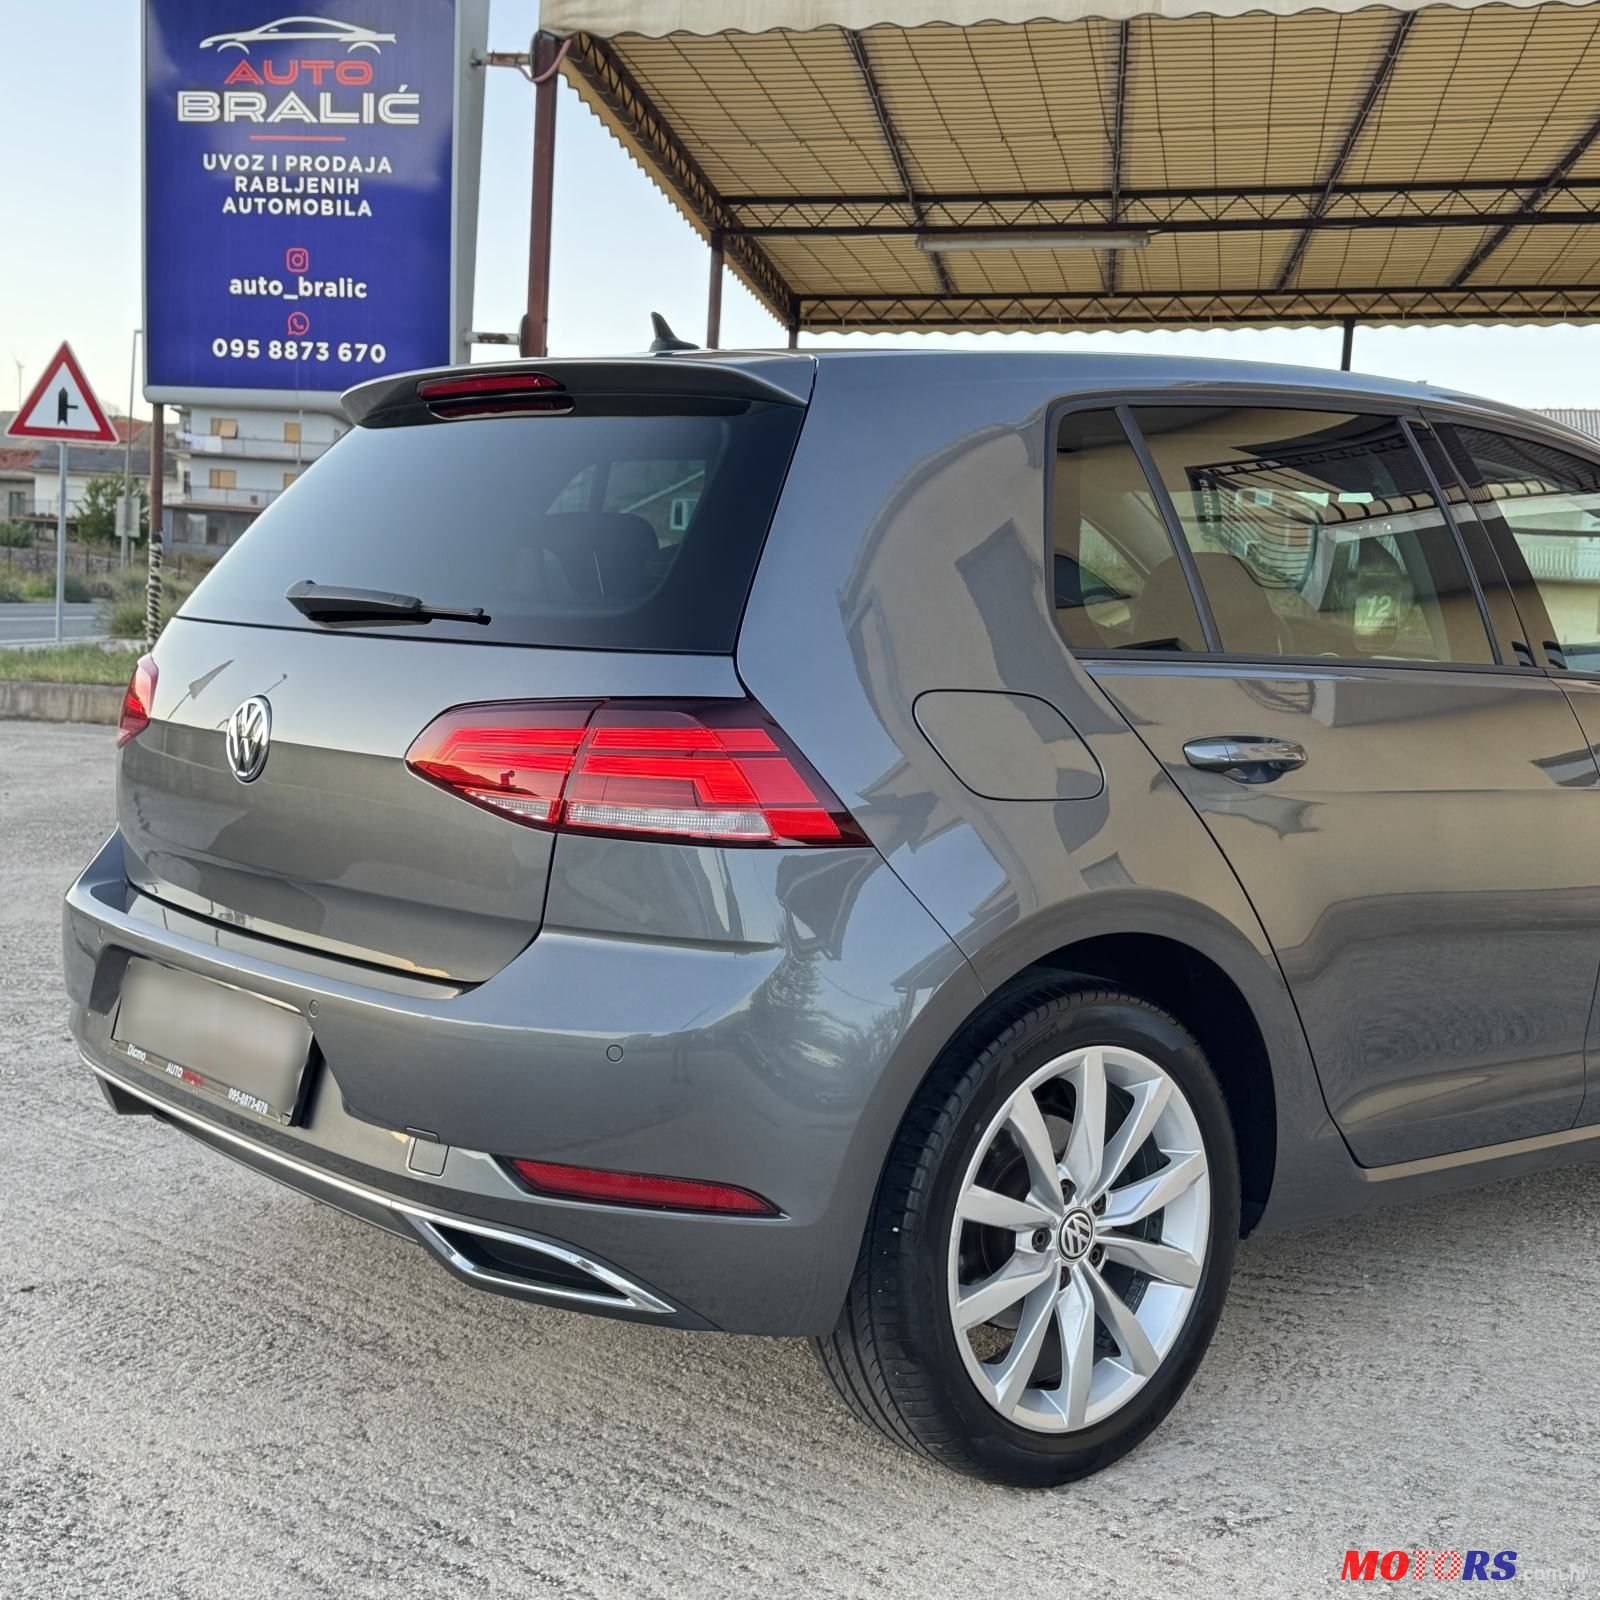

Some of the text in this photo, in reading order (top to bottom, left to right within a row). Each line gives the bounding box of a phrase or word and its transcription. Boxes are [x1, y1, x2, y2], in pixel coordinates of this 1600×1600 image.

[224, 59, 373, 85] AUTO
[177, 84, 420, 125] BRALIĆ
[202, 153, 392, 174] UVOZ I PRODAJA
[234, 175, 360, 195] RABLJENIH
[221, 196, 373, 217] AUTOMOBILA
[229, 276, 368, 300] auto_bralic
[211, 338, 387, 364] 095 8873 670
[1367, 595, 1392, 617] 12
[166, 1062, 184, 1078] AUTO
